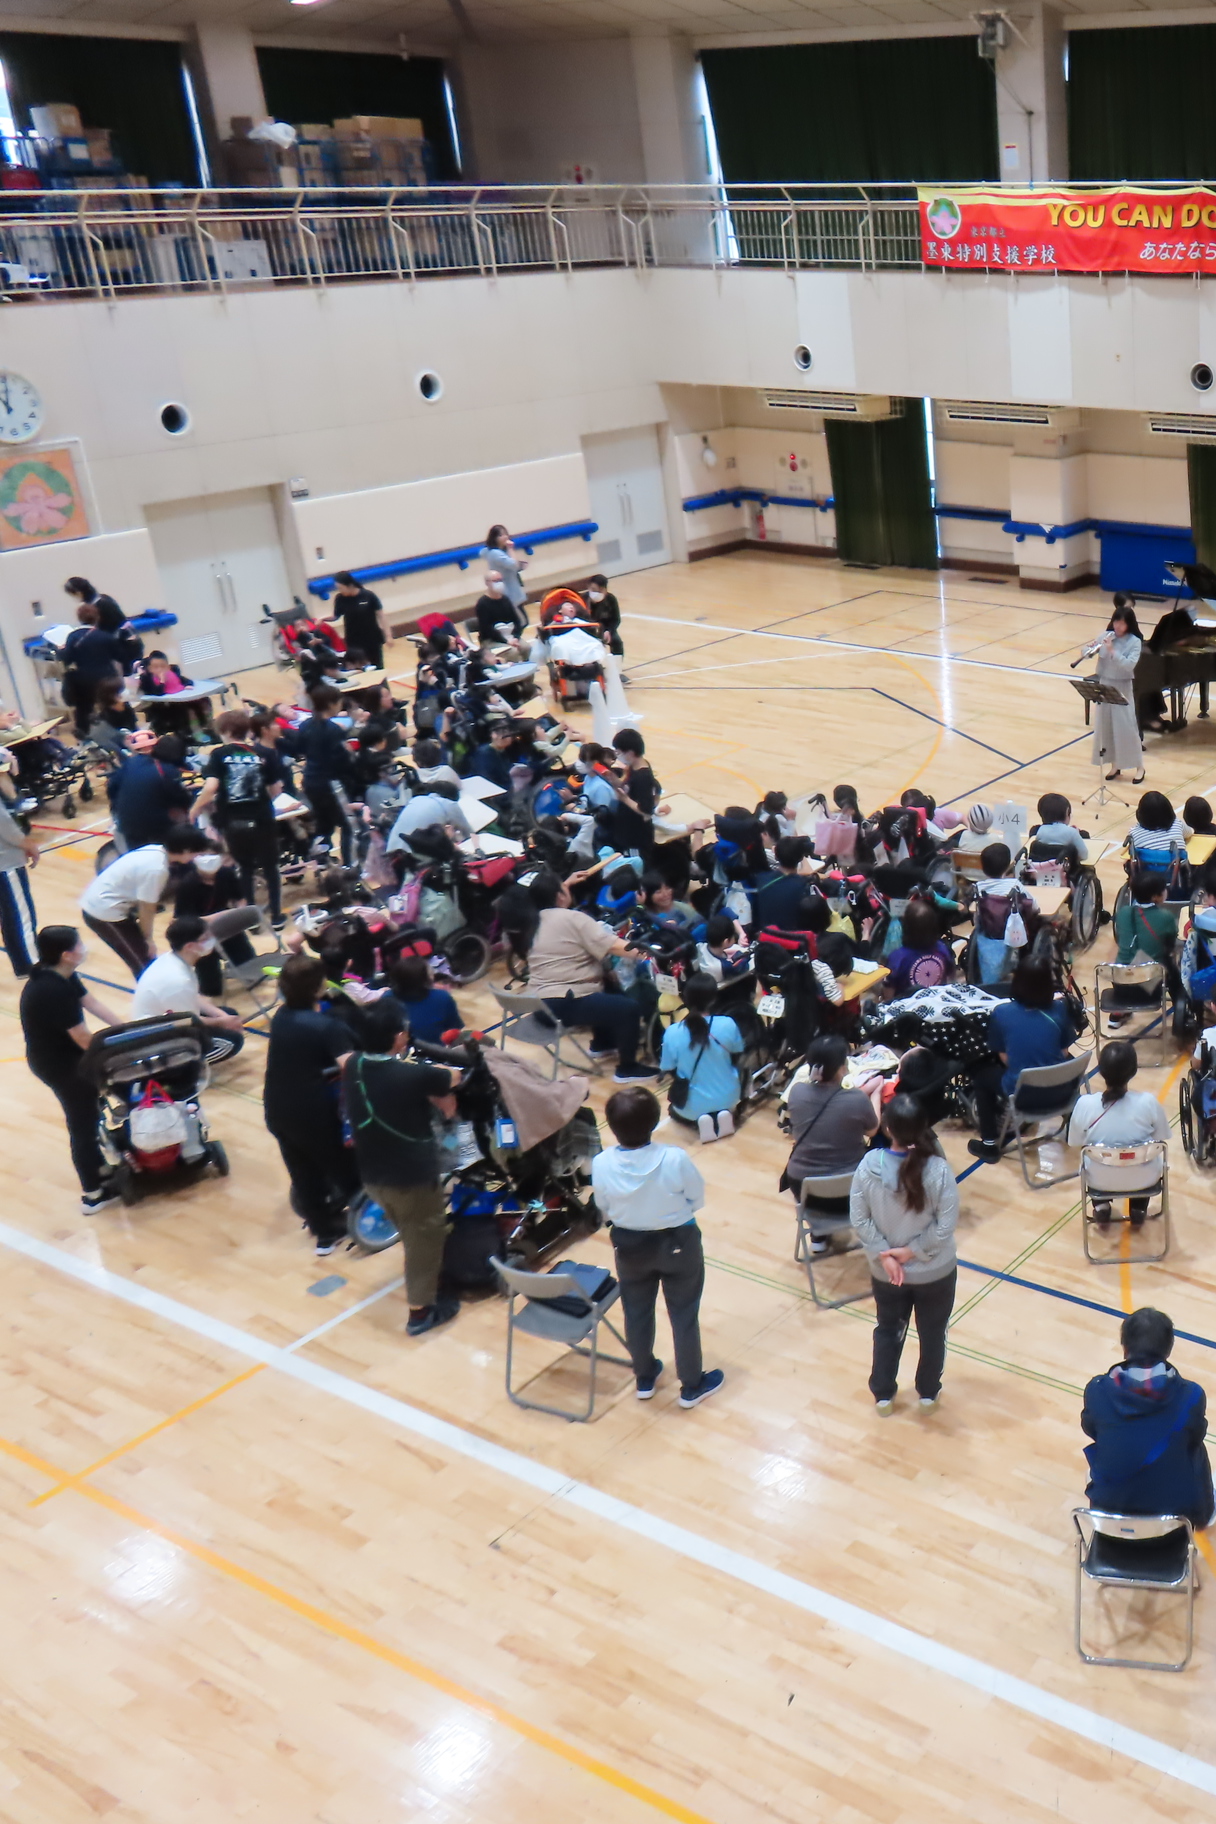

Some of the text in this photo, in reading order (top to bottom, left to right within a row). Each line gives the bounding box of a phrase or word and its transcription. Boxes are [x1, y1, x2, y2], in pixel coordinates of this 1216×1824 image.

[1046, 203, 1106, 228] YOU
[1111, 202, 1174, 229] CAN
[926, 241, 1057, 266] 墨東特別支援学校
[998, 813, 1021, 825] 小4
